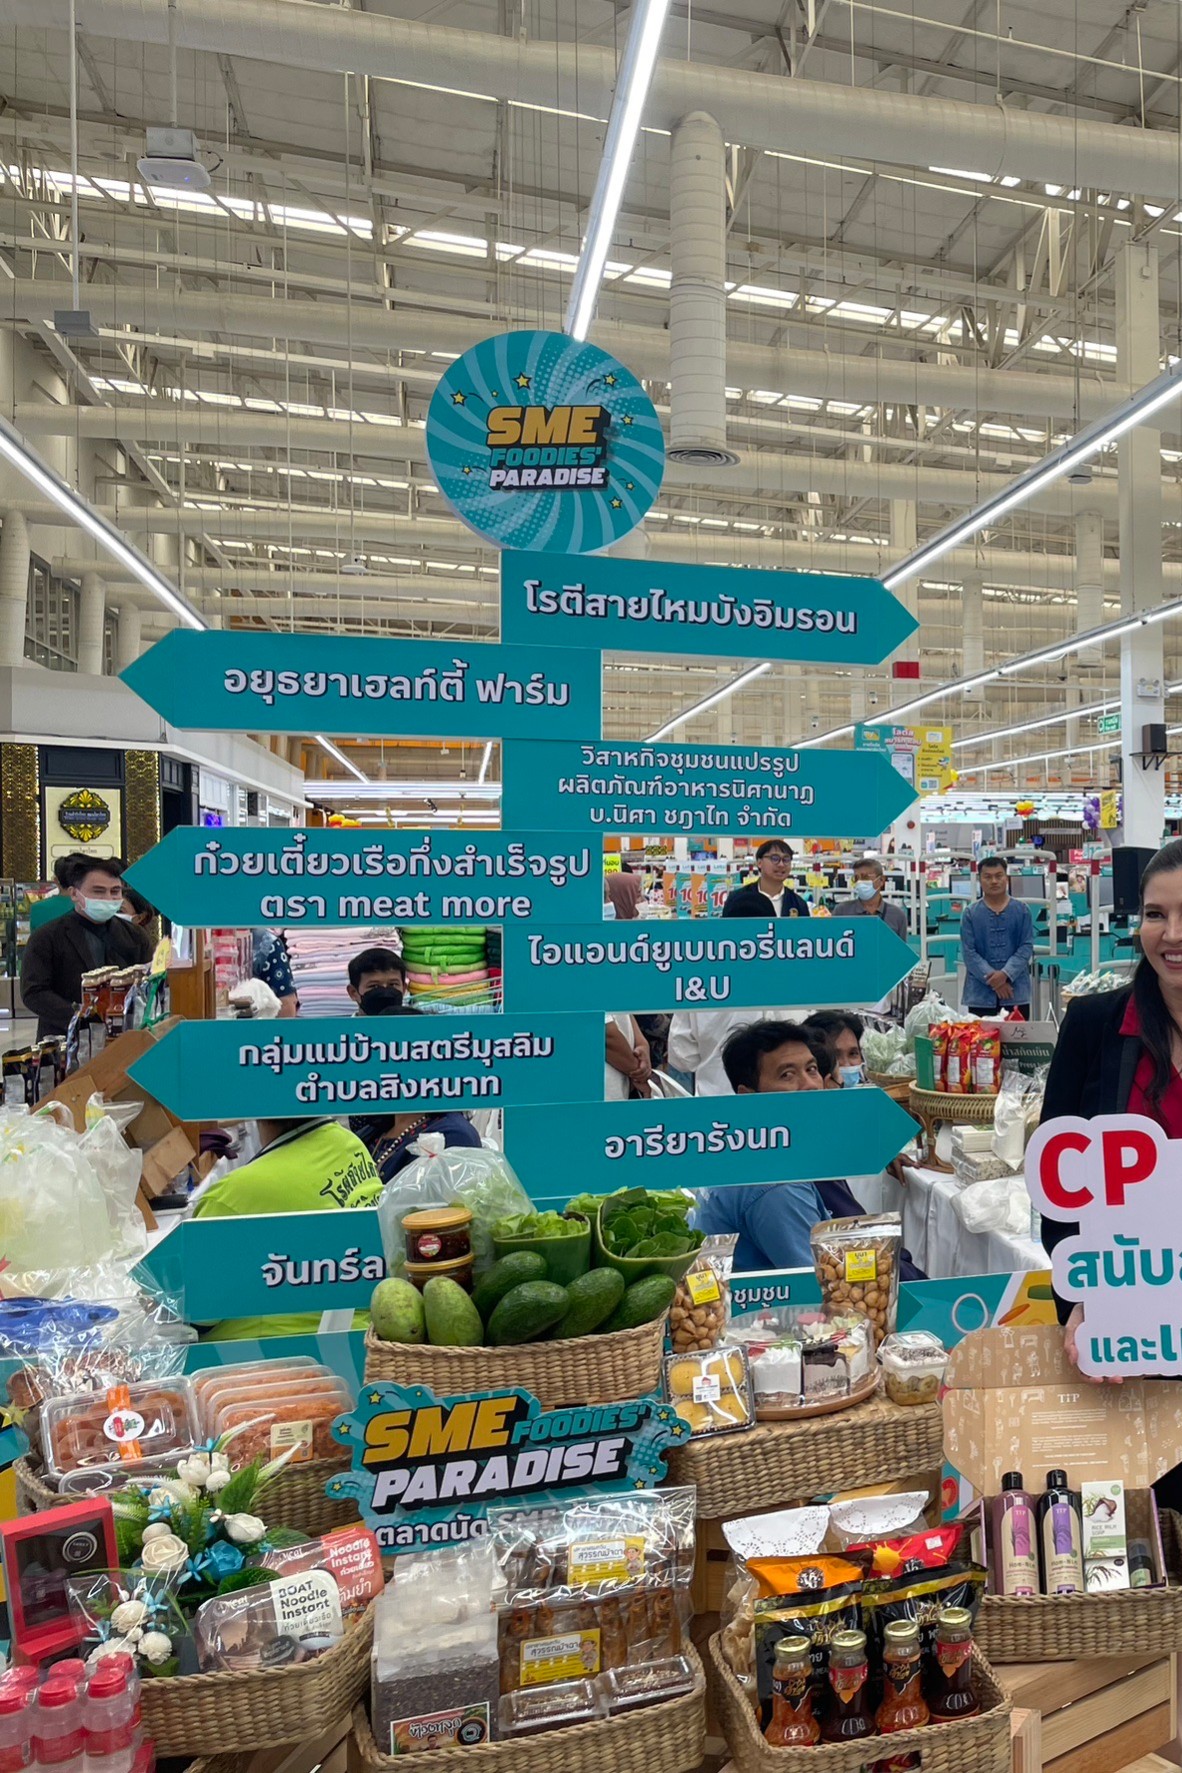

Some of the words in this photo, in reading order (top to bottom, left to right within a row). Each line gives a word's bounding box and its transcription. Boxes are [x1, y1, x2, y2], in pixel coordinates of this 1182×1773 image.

[486, 405, 602, 445] SME
[489, 446, 602, 467] FOODIES'
[489, 467, 606, 487] PARADISE
[524, 579, 858, 634] โรตีสายไหมบังอิมรอน
[224, 658, 468, 706] อยุธยาเฮลท์ตี้
[476, 671, 570, 706] ฟาร์ม
[582, 745, 800, 778] วิสาหกิจชุมชนแปรรูป
[590, 804, 657, 826] บ.นิศา
[737, 806, 791, 828] จำกัด
[194, 832, 590, 885] ก๋วยเตี๋ยวเรือกึ่งสำเร็จรูป
[260, 893, 326, 919] ตรา
[338, 893, 431, 919] meat
[441, 894, 532, 919] more
[528, 922, 856, 971] ไอแอนด์ยูเบเกอรี่แลนด์
[675, 975, 731, 1001] I&U
[239, 1030, 555, 1074] กลุ่มแม่บ้านสตรีมุสลิม
[295, 1072, 502, 1102] ตำบลสิงหนาท
[605, 1121, 791, 1159] อารียารังนก
[1039, 1129, 1158, 1208] CP
[730, 1284, 790, 1309] ชุมชน
[362, 1395, 518, 1464] SME
[512, 1404, 647, 1444] FOODIES'
[371, 1437, 627, 1508] PARADISE
[376, 1513, 489, 1547] ตลาดนัด
[279, 1580, 313, 1599] BOAT
[281, 1588, 328, 1610] Noodle
[282, 1600, 331, 1621] Instant
